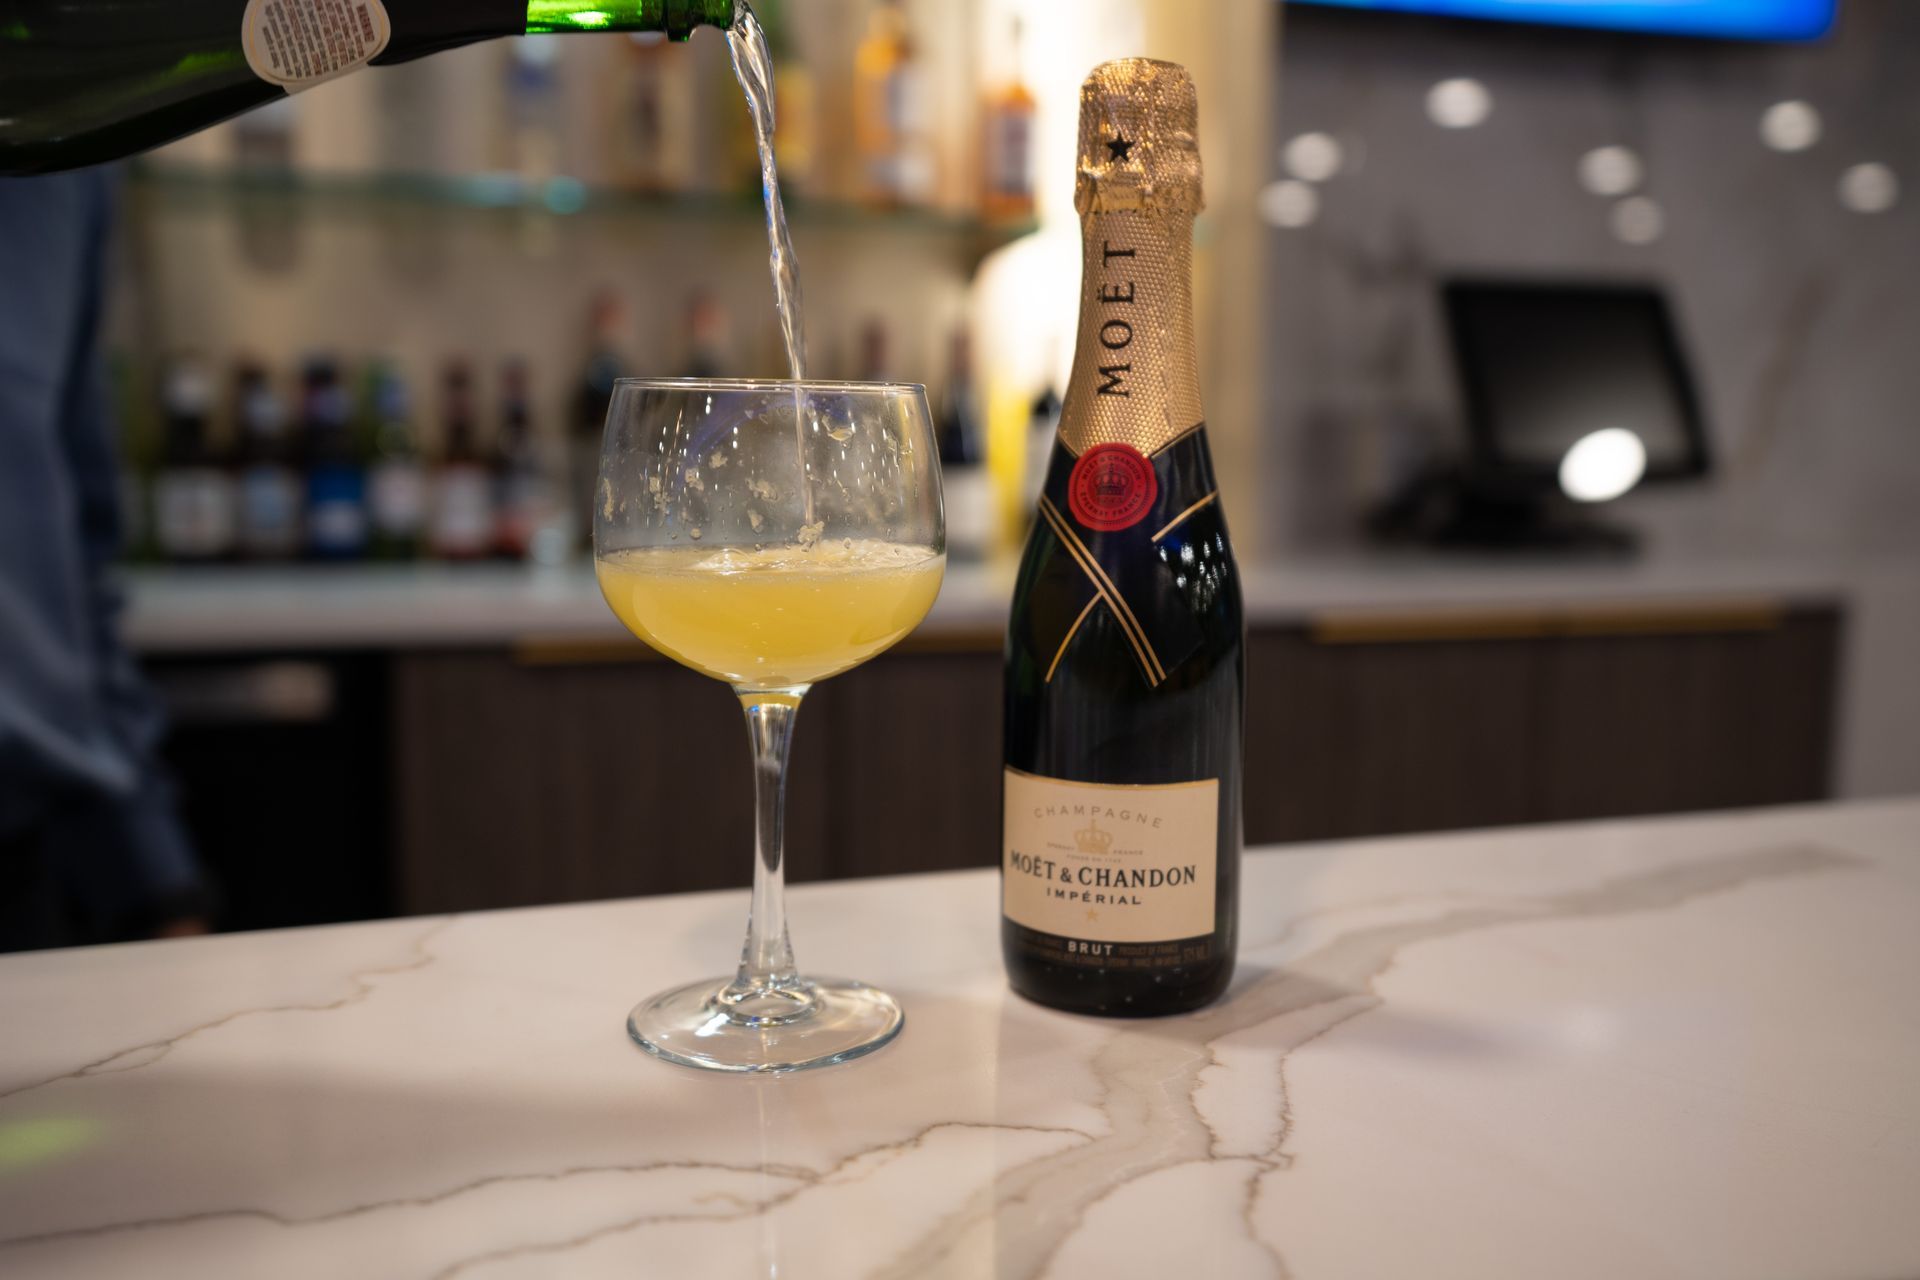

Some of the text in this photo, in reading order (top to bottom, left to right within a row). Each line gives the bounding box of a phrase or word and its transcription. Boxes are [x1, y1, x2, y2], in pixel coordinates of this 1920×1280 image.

[1097, 240, 1136, 399] MOËT
[1033, 804, 1163, 829] CHAMPAGNE
[1010, 849, 1197, 888] MOËT & CHANDON
[1046, 887, 1142, 906] IMPÉRIAL
[1068, 940, 1114, 956] BRUT
